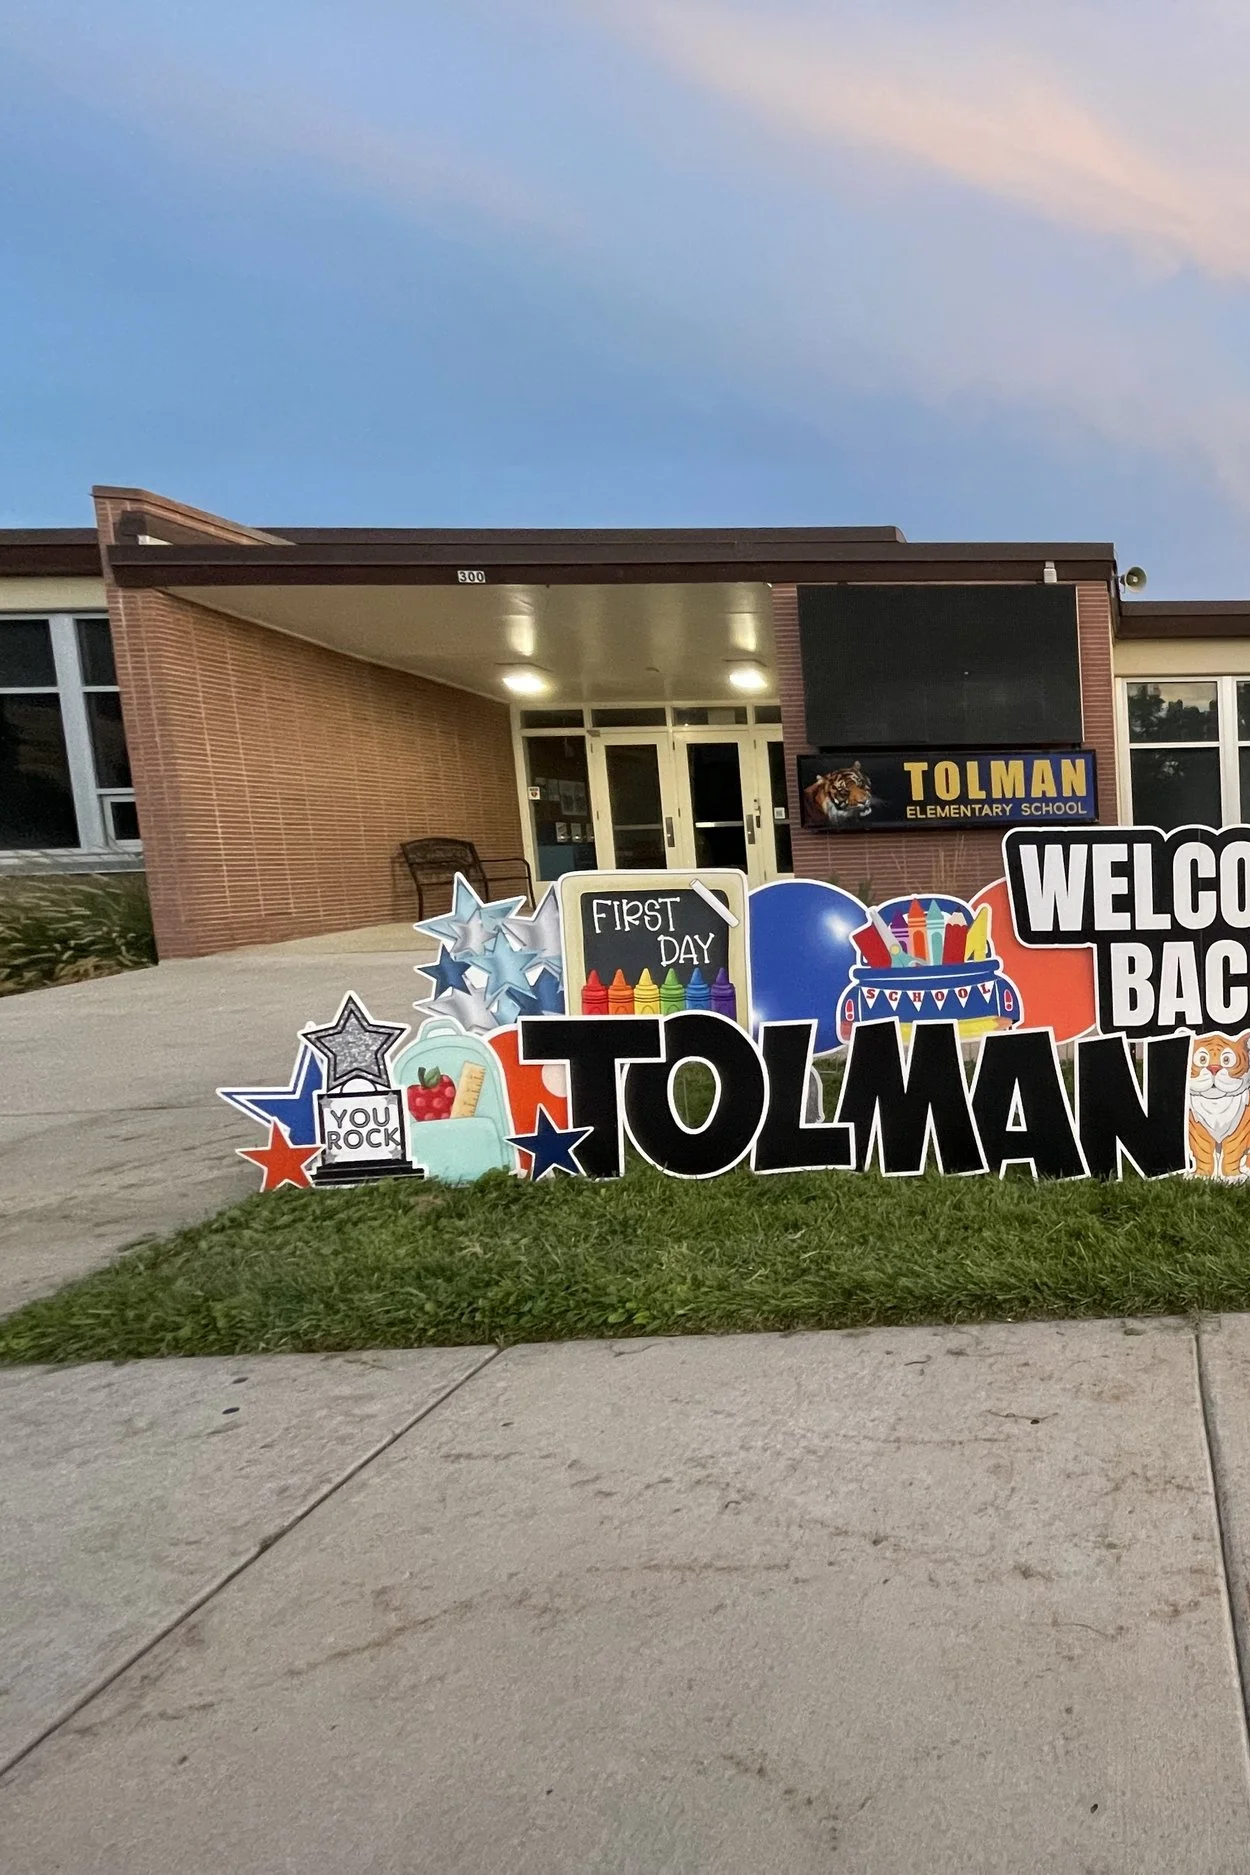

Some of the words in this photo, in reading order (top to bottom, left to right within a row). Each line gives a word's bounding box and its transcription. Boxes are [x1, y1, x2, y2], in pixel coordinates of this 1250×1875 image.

[459, 571, 484, 582] 300
[903, 758, 1087, 801] TOLMAN
[906, 804, 1013, 818] ELEMENTARY
[1021, 802, 1087, 816] SCHOOL
[592, 897, 680, 933] FIRST
[657, 933, 715, 967] DAY
[866, 983, 991, 1003] SCHOOL
[520, 1012, 1192, 1180] TOLMAN
[330, 1107, 390, 1128] YOU
[327, 1127, 401, 1150] ROCK
